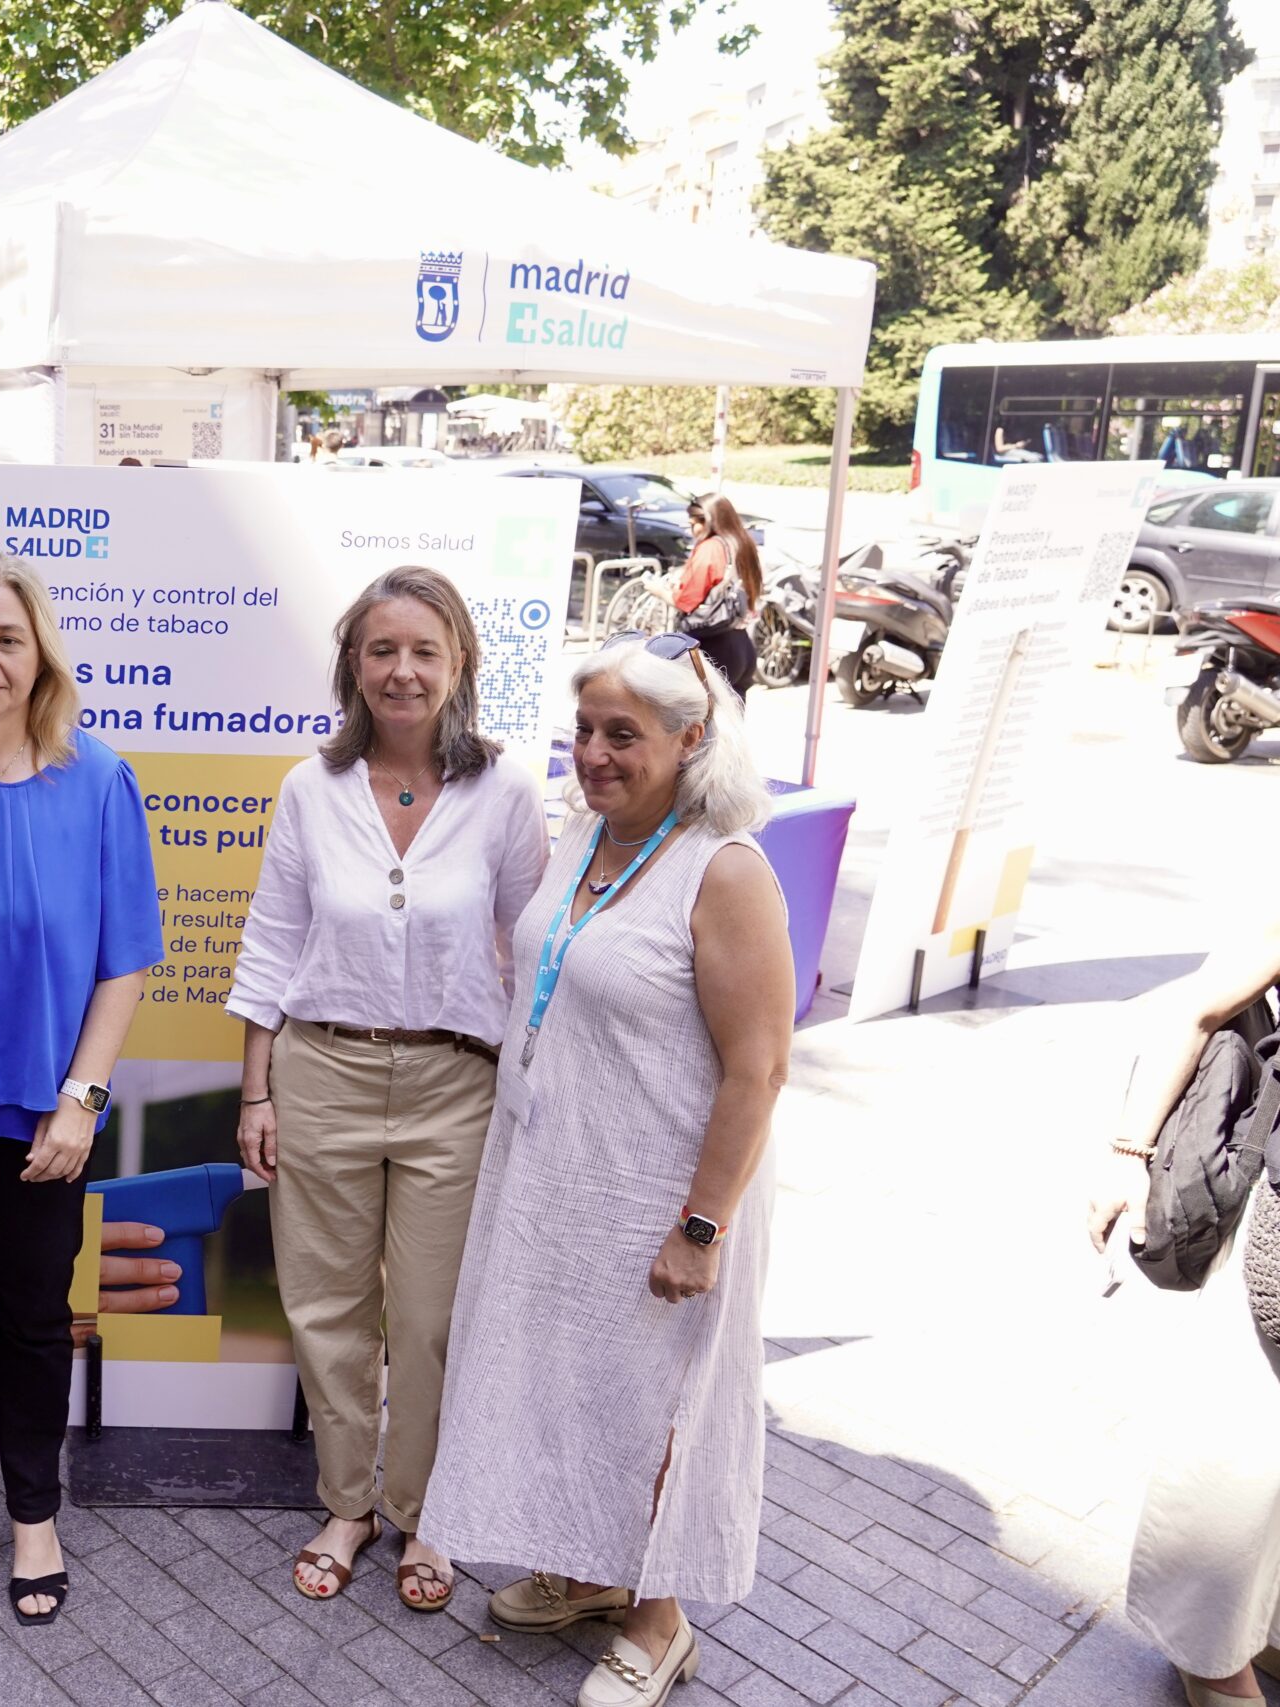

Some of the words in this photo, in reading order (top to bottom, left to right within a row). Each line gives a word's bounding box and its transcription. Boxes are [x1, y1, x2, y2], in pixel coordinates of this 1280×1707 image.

[510, 258, 631, 300] madrid
[541, 308, 629, 350] salud
[99, 423, 115, 438] 31
[119, 431, 131, 439] sin
[133, 423, 163, 431] Mundial
[98, 448, 125, 456] Madrid
[126, 448, 137, 456] sin
[138, 448, 163, 456] tabaco
[6, 506, 110, 534] MADRID
[5, 536, 82, 558] SALUD
[340, 530, 411, 550] Somos
[418, 532, 475, 551] Salud
[131, 588, 146, 608] y
[153, 585, 236, 606] control
[243, 586, 279, 607] del
[110, 613, 139, 632] de
[147, 613, 229, 634] tabaco
[105, 662, 172, 686] una
[144, 793, 273, 814] conocer
[159, 825, 208, 847] tus
[217, 824, 270, 853] pul
[176, 884, 256, 903] hacem
[169, 935, 197, 953] de
[183, 964, 231, 983] para
[151, 985, 179, 1003] de
